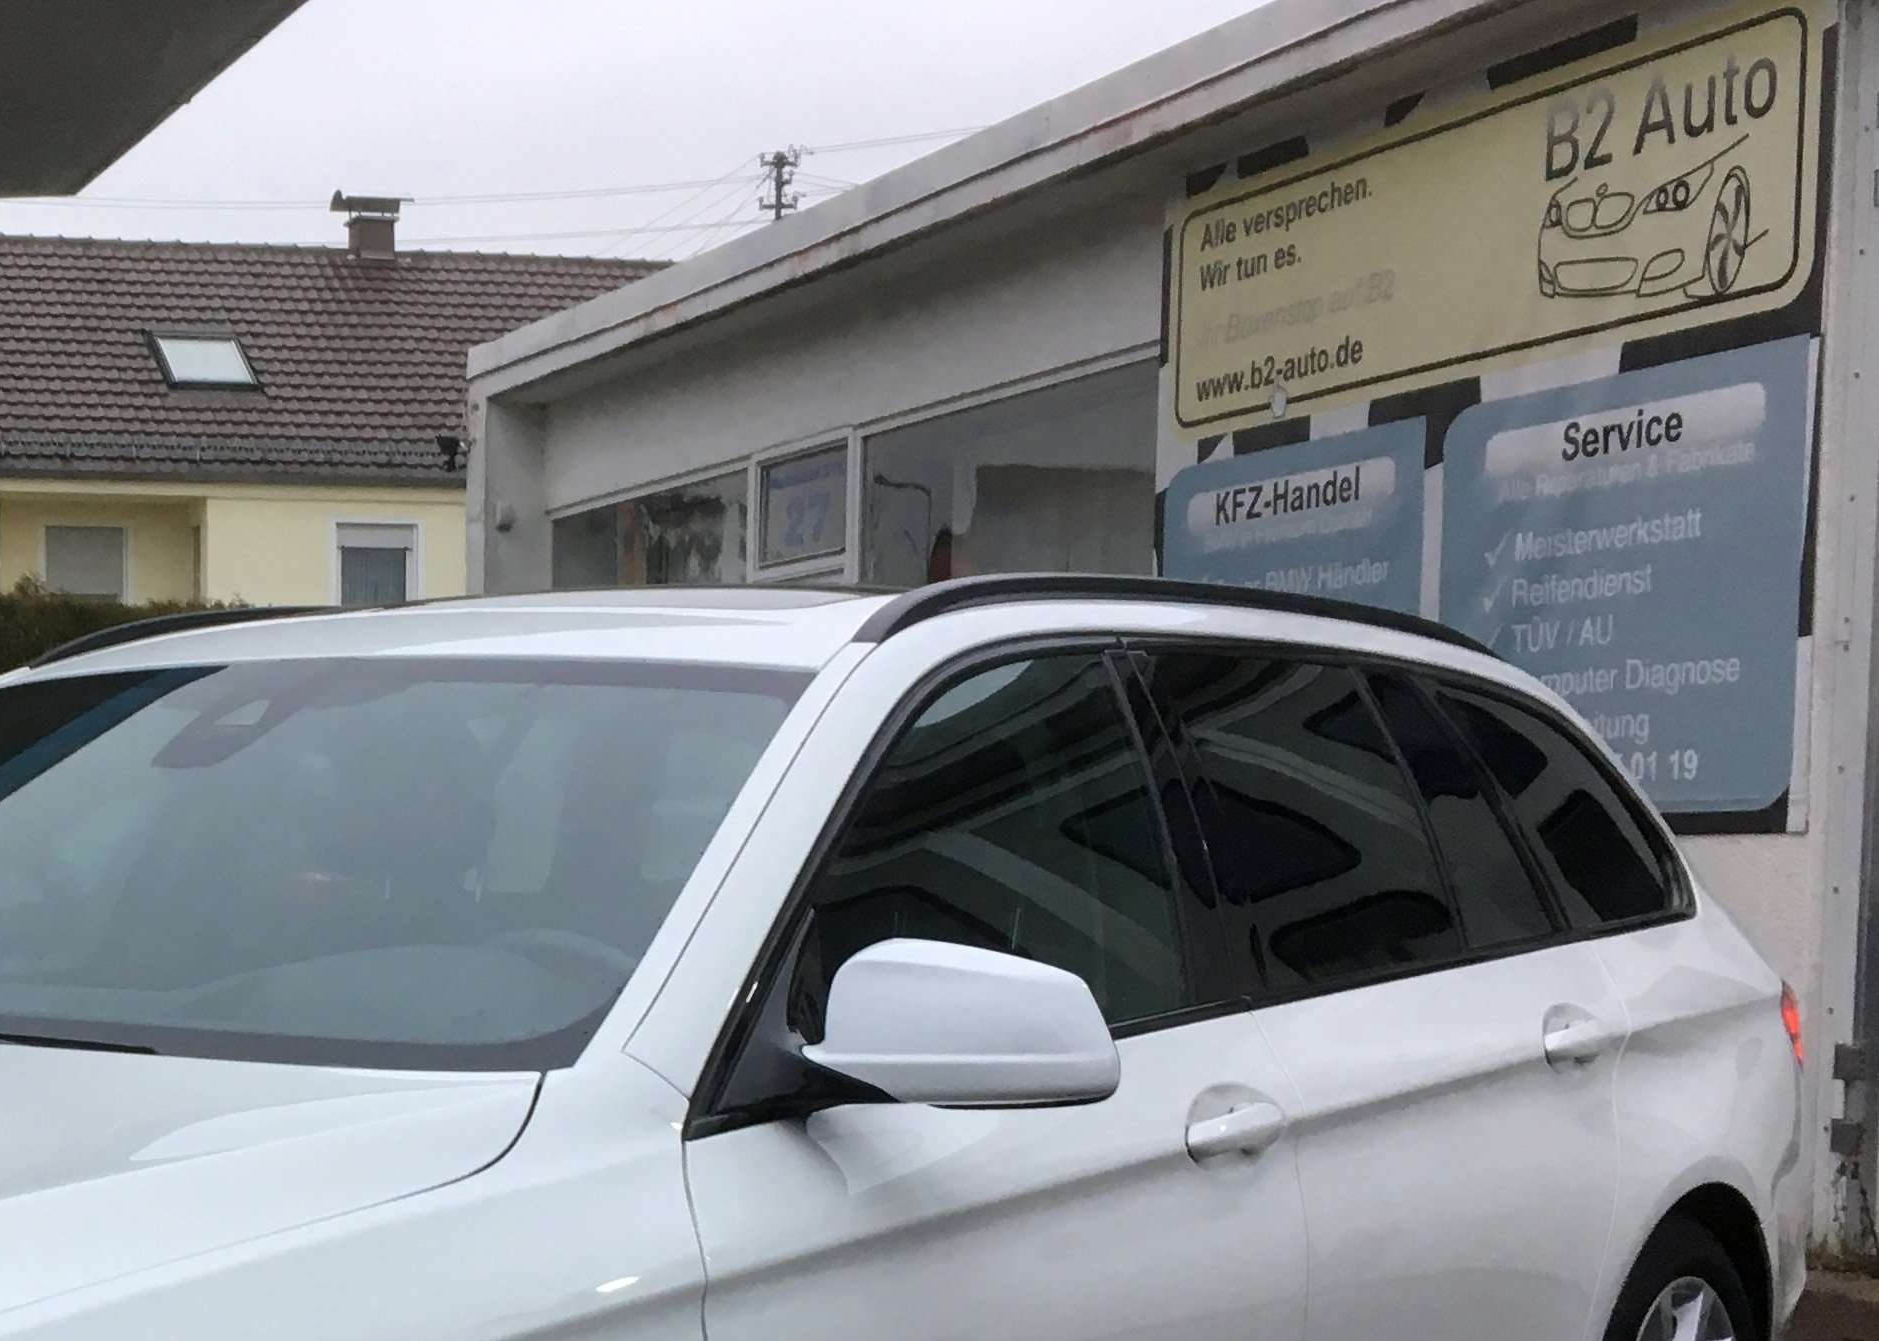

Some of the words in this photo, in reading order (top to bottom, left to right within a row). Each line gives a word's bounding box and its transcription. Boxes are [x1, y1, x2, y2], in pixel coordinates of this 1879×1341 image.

[1546, 84, 1615, 181] B2
[1633, 53, 1777, 156] Auto
[1200, 218, 1237, 252] Alle
[1242, 176, 1373, 236] versprechen.
[1200, 259, 1231, 291] Wir
[1237, 253, 1268, 281] tun
[1274, 243, 1302, 270] es.
[1196, 335, 1364, 402] www.b2-auto.de
[1561, 408, 1683, 461] Service
[1215, 466, 1360, 526] KFZ-Handel
[1513, 507, 1702, 562] Meisterwerkstatt
[1317, 557, 1390, 590] Händler
[1512, 563, 1653, 607] Reifendienst
[1511, 615, 1562, 653] TÜV
[1578, 613, 1614, 647] AU
[1624, 657, 1741, 695] Diagnose
[1668, 748, 1699, 781] 19
